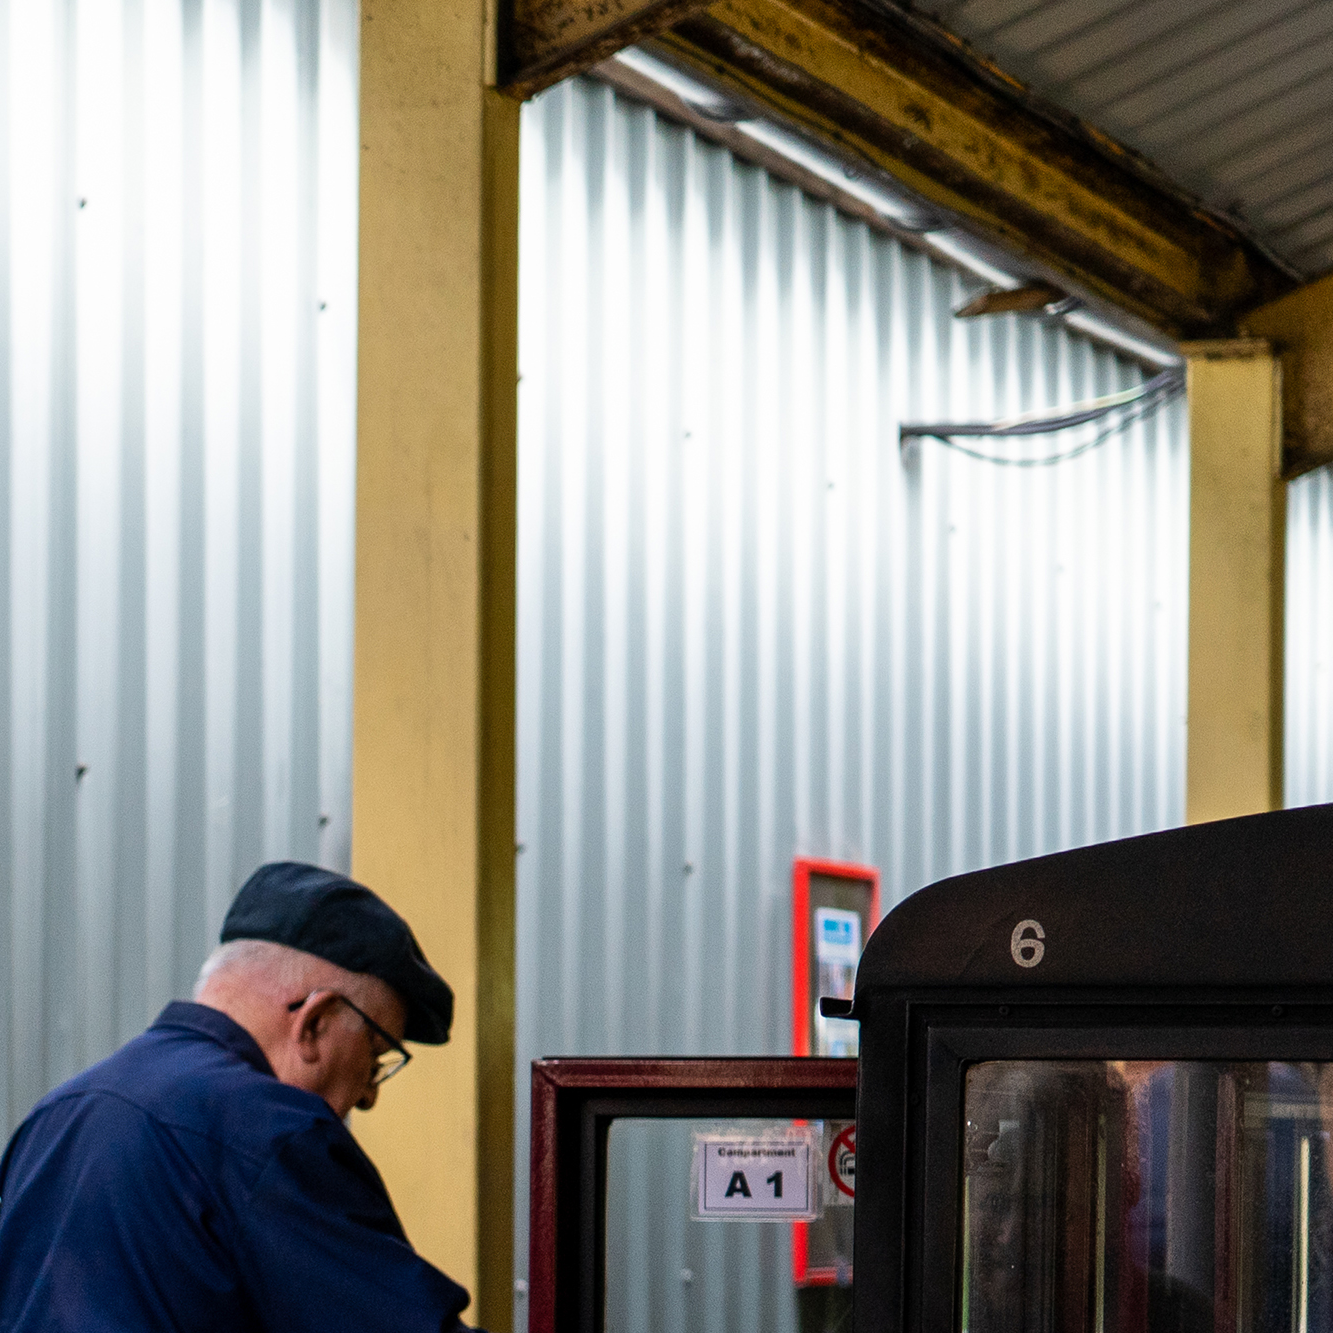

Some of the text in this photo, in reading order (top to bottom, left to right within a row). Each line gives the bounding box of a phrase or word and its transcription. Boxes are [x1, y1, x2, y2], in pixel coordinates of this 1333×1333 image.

[1011, 919, 1045, 968] 6
[718, 1147, 796, 1158] Compartment
[725, 1170, 783, 1198] A 1
